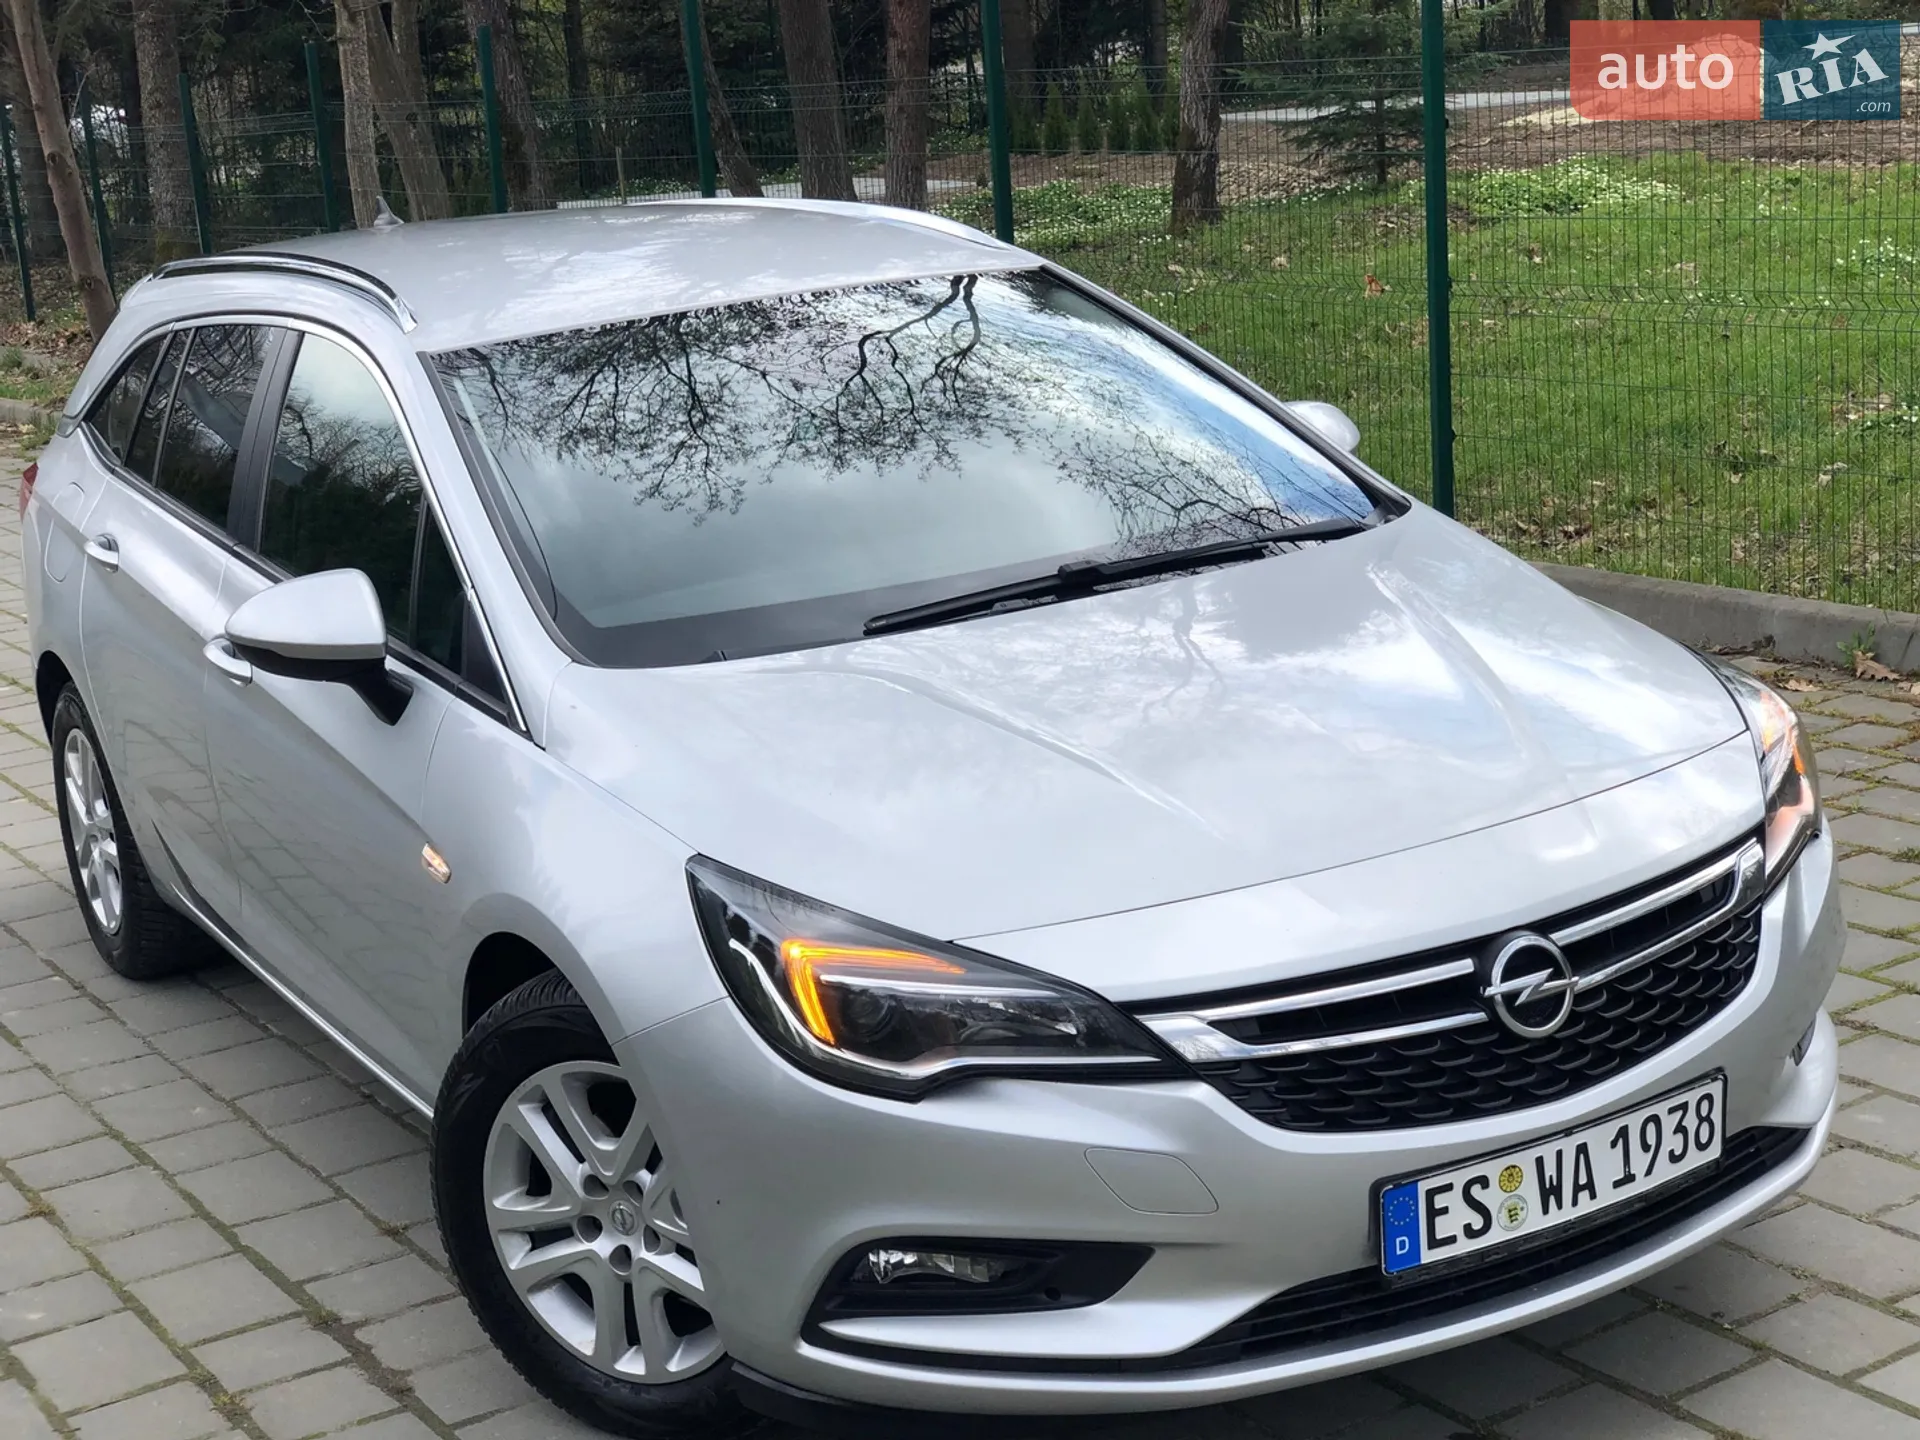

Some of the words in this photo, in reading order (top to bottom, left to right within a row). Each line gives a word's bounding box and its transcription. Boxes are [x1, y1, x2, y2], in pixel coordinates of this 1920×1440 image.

[1425, 1175, 1492, 1250] ES
[1535, 1142, 1597, 1215] WA
[1610, 1093, 1715, 1189] 1938
[1395, 1236, 1409, 1255] D
